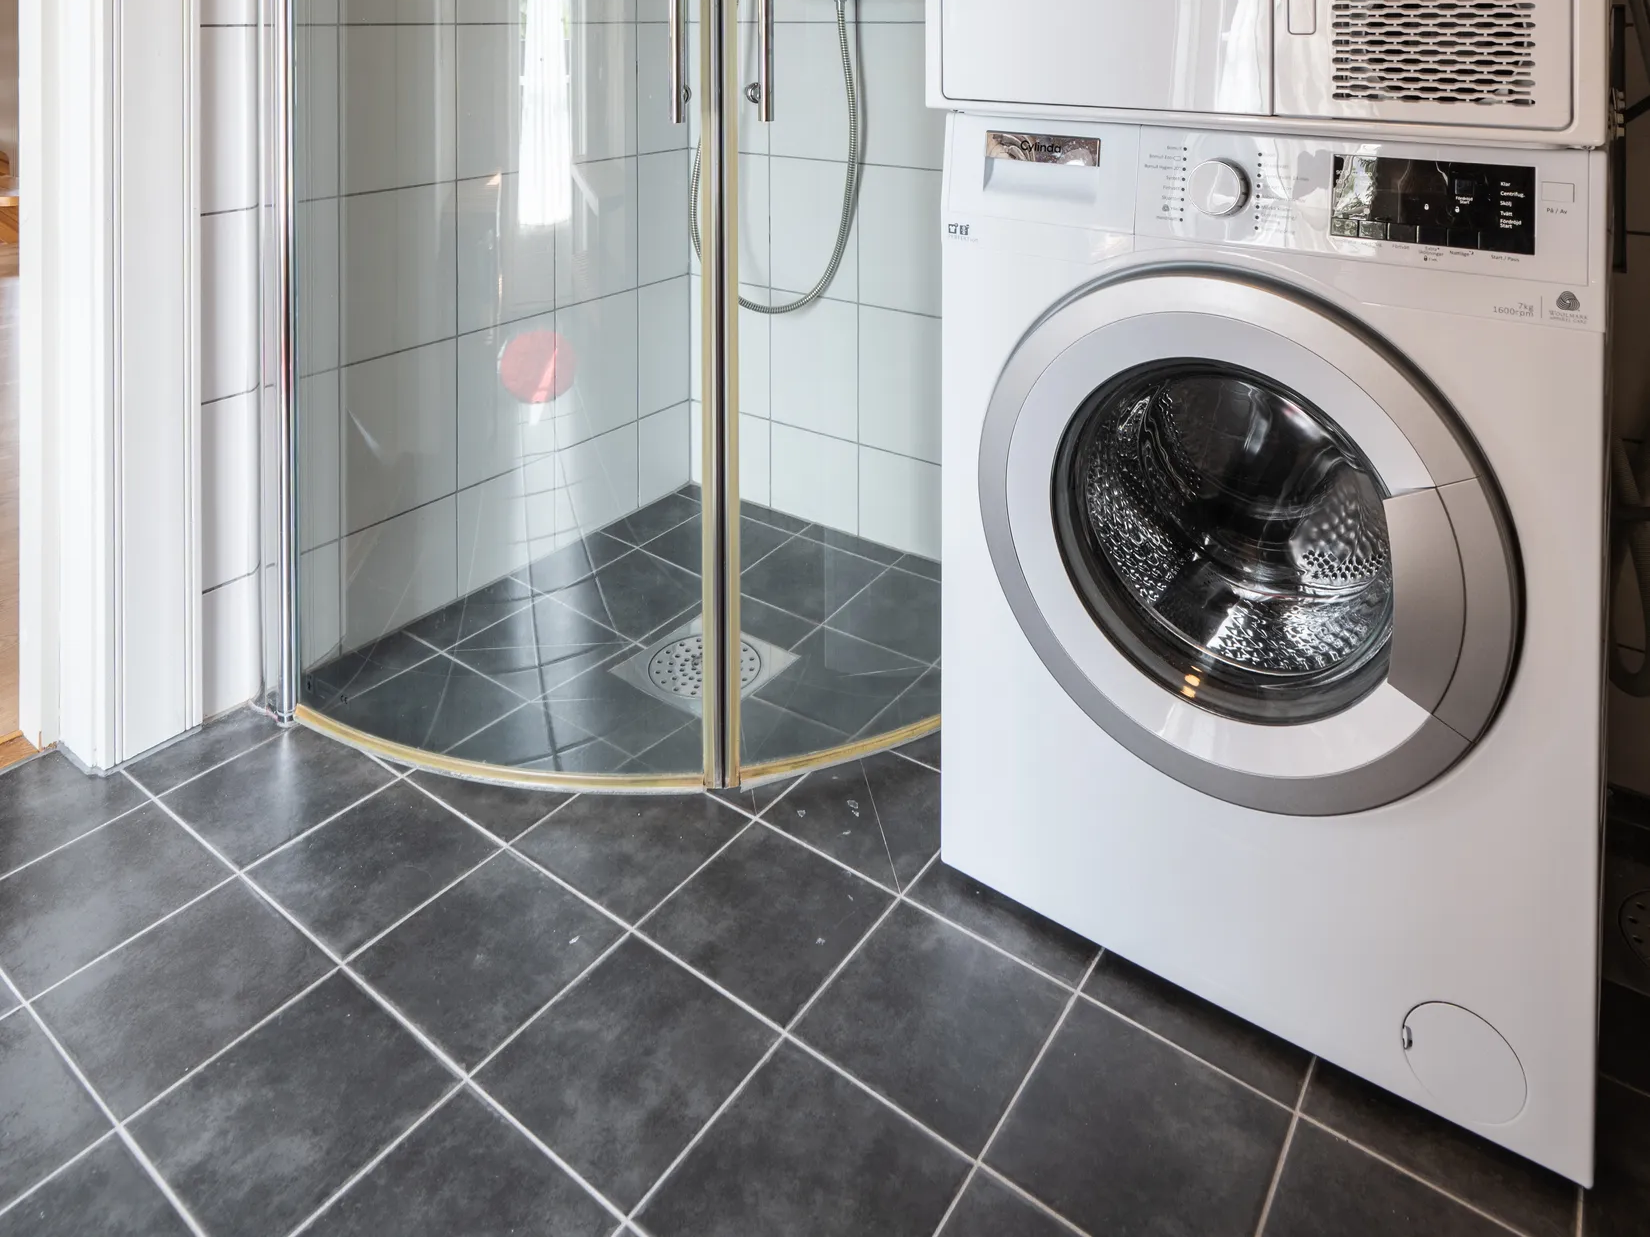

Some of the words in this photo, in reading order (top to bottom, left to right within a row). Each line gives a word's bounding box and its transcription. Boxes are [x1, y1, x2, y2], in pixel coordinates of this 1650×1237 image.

[1020, 140, 1061, 154] Cylinda
[1500, 190, 1526, 198] Centrifug.
[1500, 200, 1513, 208] Skölj
[1493, 306, 1534, 318] 1600rpm
[1518, 302, 1534, 313] 7kg
[1549, 310, 1588, 320] WOOLMARK
